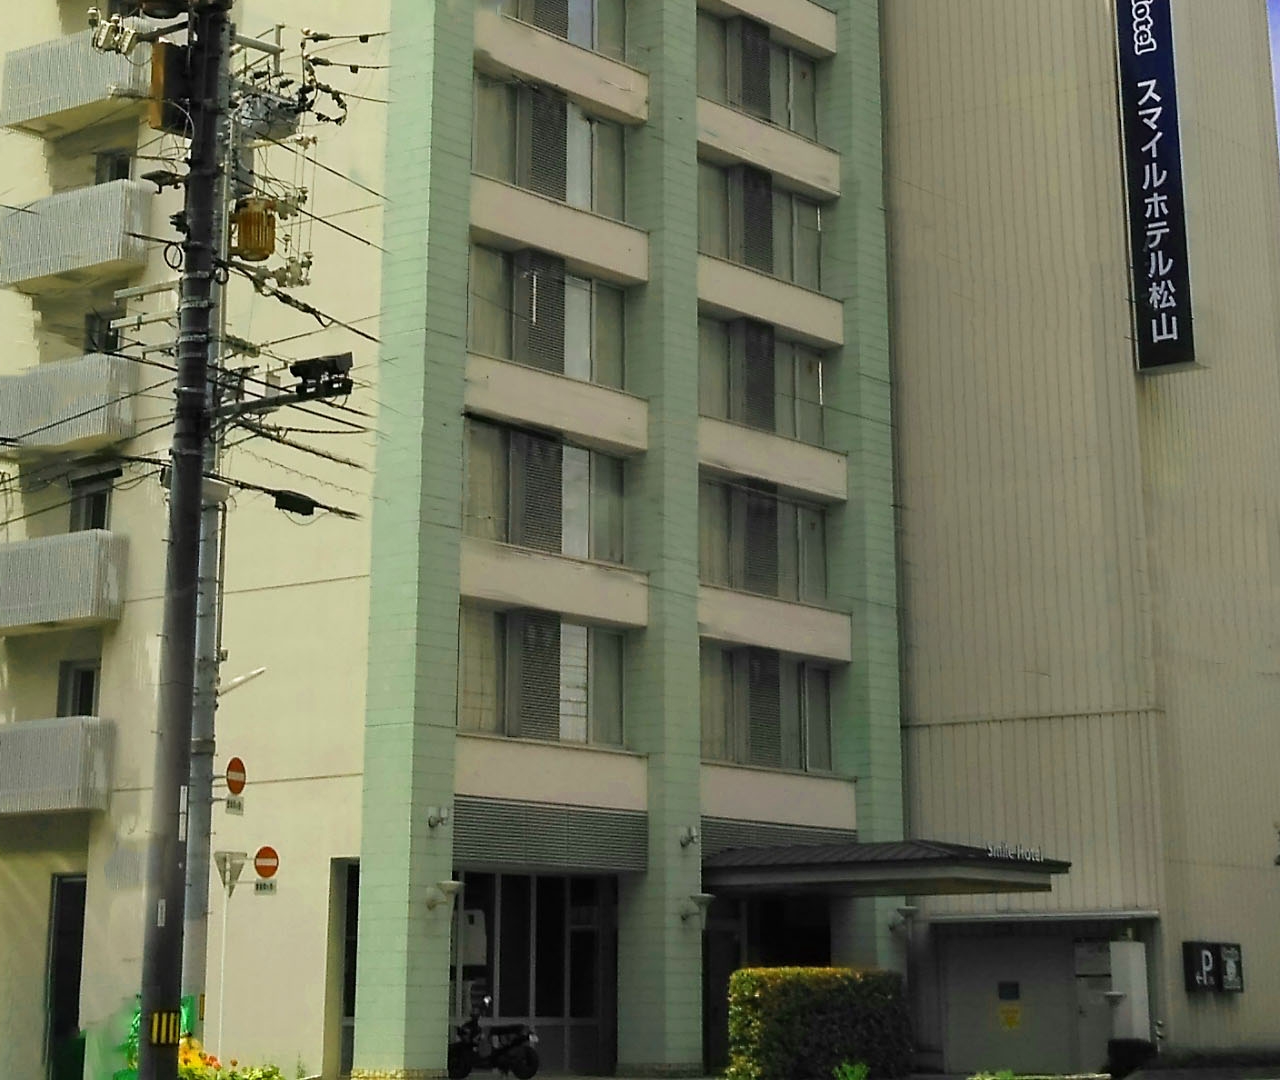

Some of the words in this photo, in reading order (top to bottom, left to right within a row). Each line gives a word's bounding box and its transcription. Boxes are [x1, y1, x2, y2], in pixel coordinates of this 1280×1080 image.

[1137, 80, 1179, 344] スマイルホテル松山
[1201, 949, 1214, 985] P
